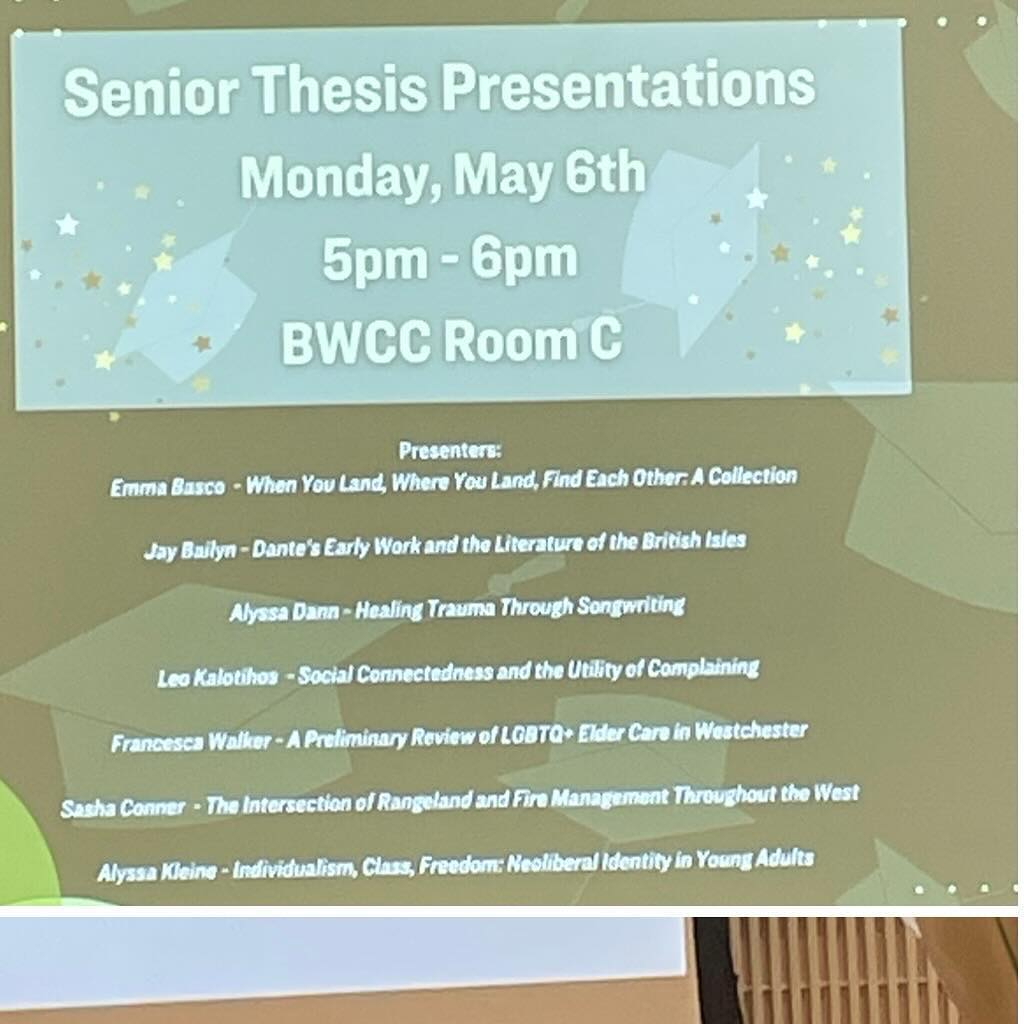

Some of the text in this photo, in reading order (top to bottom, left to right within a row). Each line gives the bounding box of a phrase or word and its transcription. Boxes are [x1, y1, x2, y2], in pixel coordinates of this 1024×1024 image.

[65, 58, 815, 116] Senior Thesis Presentations
[242, 149, 645, 204] Monday, May 6th
[324, 235, 576, 288] 5pm - 6pm
[284, 316, 621, 364] BWCC Room C
[399, 440, 502, 460] Presenters:
[110, 477, 168, 498] Emma
[170, 476, 226, 497] Basco
[246, 474, 298, 495] When
[301, 474, 336, 494] You
[338, 472, 388, 495] Land,
[391, 472, 451, 492] Where
[454, 471, 488, 491] You
[490, 469, 540, 491] Land,
[542, 468, 584, 489] Find
[585, 467, 630, 488] Each
[632, 467, 689, 488] Other:
[690, 466, 705, 486] A
[708, 465, 798, 486] Collection
[143, 542, 179, 563] Jay
[180, 539, 238, 563] Bailyn
[251, 538, 321, 559] Dante's
[323, 536, 372, 560] Early
[373, 535, 423, 556] Work
[423, 534, 460, 555] and
[461, 533, 492, 554] the
[494, 533, 585, 554] Literature
[586, 531, 607, 552] of
[608, 531, 639, 551] the
[641, 529, 702, 551] British
[704, 529, 747, 549] Isles
[228, 601, 289, 625] Alyssa
[292, 601, 340, 622] Dann
[354, 599, 424, 623] Healing
[426, 598, 496, 619] Trauma
[500, 596, 575, 620] Through
[576, 594, 687, 618] Songwriting
[157, 669, 191, 689] Leo
[297, 664, 355, 685] Social
[356, 661, 495, 684] Connectedness
[496, 660, 533, 681] and
[534, 659, 565, 680] the
[567, 658, 624, 682] Utility
[624, 657, 646, 679] of
[647, 656, 761, 680] Complaining
[111, 733, 204, 753] Francesca
[208, 730, 273, 751] Walker
[286, 729, 301, 749] A
[304, 728, 409, 751] Preliminary
[410, 727, 477, 747] Review
[478, 725, 500, 745] of
[500, 723, 574, 745] LGBTQ+
[578, 723, 626, 743] Elder
[627, 722, 671, 742] Care
[673, 722, 691, 741] in
[695, 719, 809, 741] Westchester
[60, 798, 117, 819] Sasha
[119, 798, 187, 818] Conner
[206, 795, 240, 815] The
[242, 793, 352, 814] Intersection
[354, 791, 377, 812] of
[376, 789, 475, 814] Rangeland
[474, 788, 511, 809] and
[512, 788, 549, 808] Fire
[550, 788, 670, 810] Management
[673, 783, 778, 808] Throughout
[780, 783, 811, 803] the
[813, 782, 861, 802] West
[96, 862, 158, 886] Alyssa
[160, 861, 218, 881] Kleine
[232, 857, 359, 879] Individualism,
[361, 855, 416, 878] Class,
[418, 854, 505, 875] Freedom:
[506, 851, 600, 873] Neoliberal
[601, 851, 673, 873] Identity
[674, 850, 693, 869] in
[696, 849, 754, 872] Young
[754, 847, 815, 868] Adults
